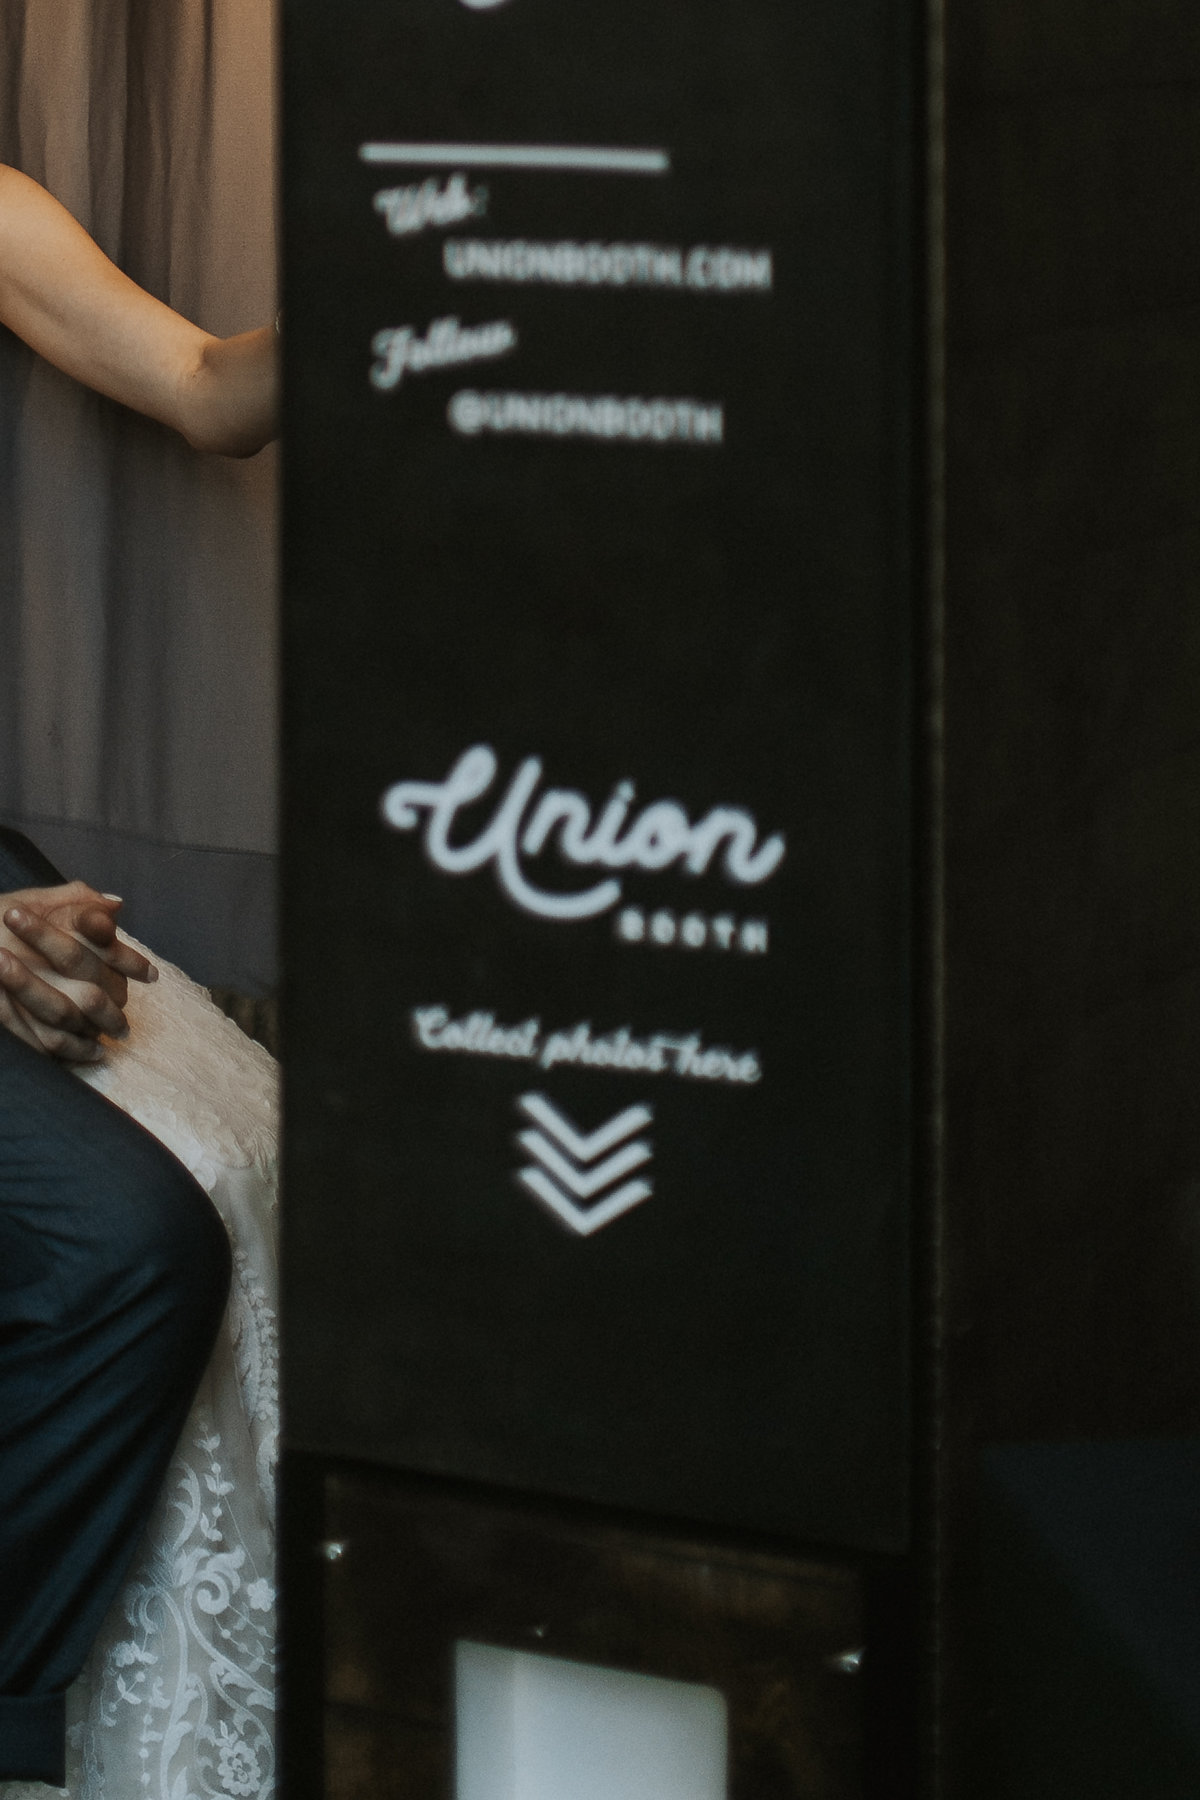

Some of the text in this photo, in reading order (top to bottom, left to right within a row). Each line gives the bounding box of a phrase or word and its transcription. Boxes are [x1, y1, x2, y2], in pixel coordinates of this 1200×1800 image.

[442, 238, 773, 292] UNIONBOOTH.COM
[447, 388, 725, 444] @UNIONBOOTH
[380, 743, 786, 921] Union
[617, 906, 769, 954] BOOTH
[411, 1003, 763, 1084] Collect photos here
